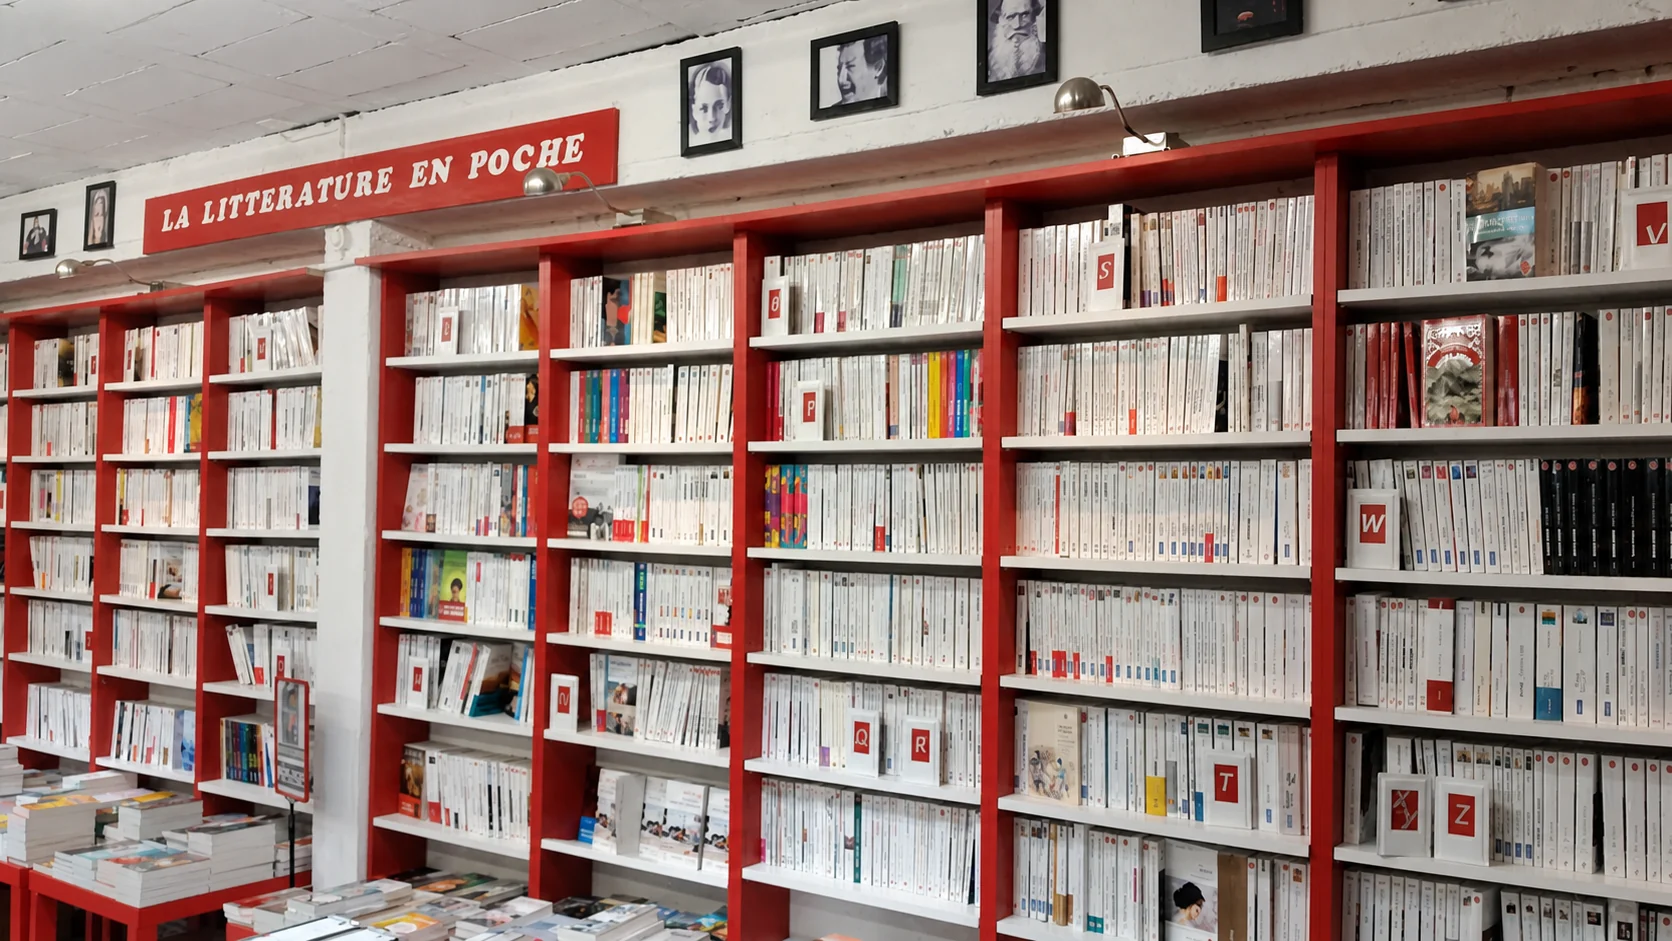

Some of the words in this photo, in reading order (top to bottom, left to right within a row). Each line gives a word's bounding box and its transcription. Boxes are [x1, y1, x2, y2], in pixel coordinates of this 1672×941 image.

[161, 206, 190, 233] LA
[201, 166, 394, 226] LITTERATURE
[410, 156, 454, 189] EN
[467, 133, 585, 180] POCHE
[1646, 222, 1667, 244] V
[1099, 261, 1111, 280] S
[807, 400, 815, 416] P
[1362, 513, 1386, 533] W
[855, 728, 869, 747] Q
[915, 736, 928, 753] R
[1219, 772, 1234, 792] T
[1454, 803, 1471, 825] Z
